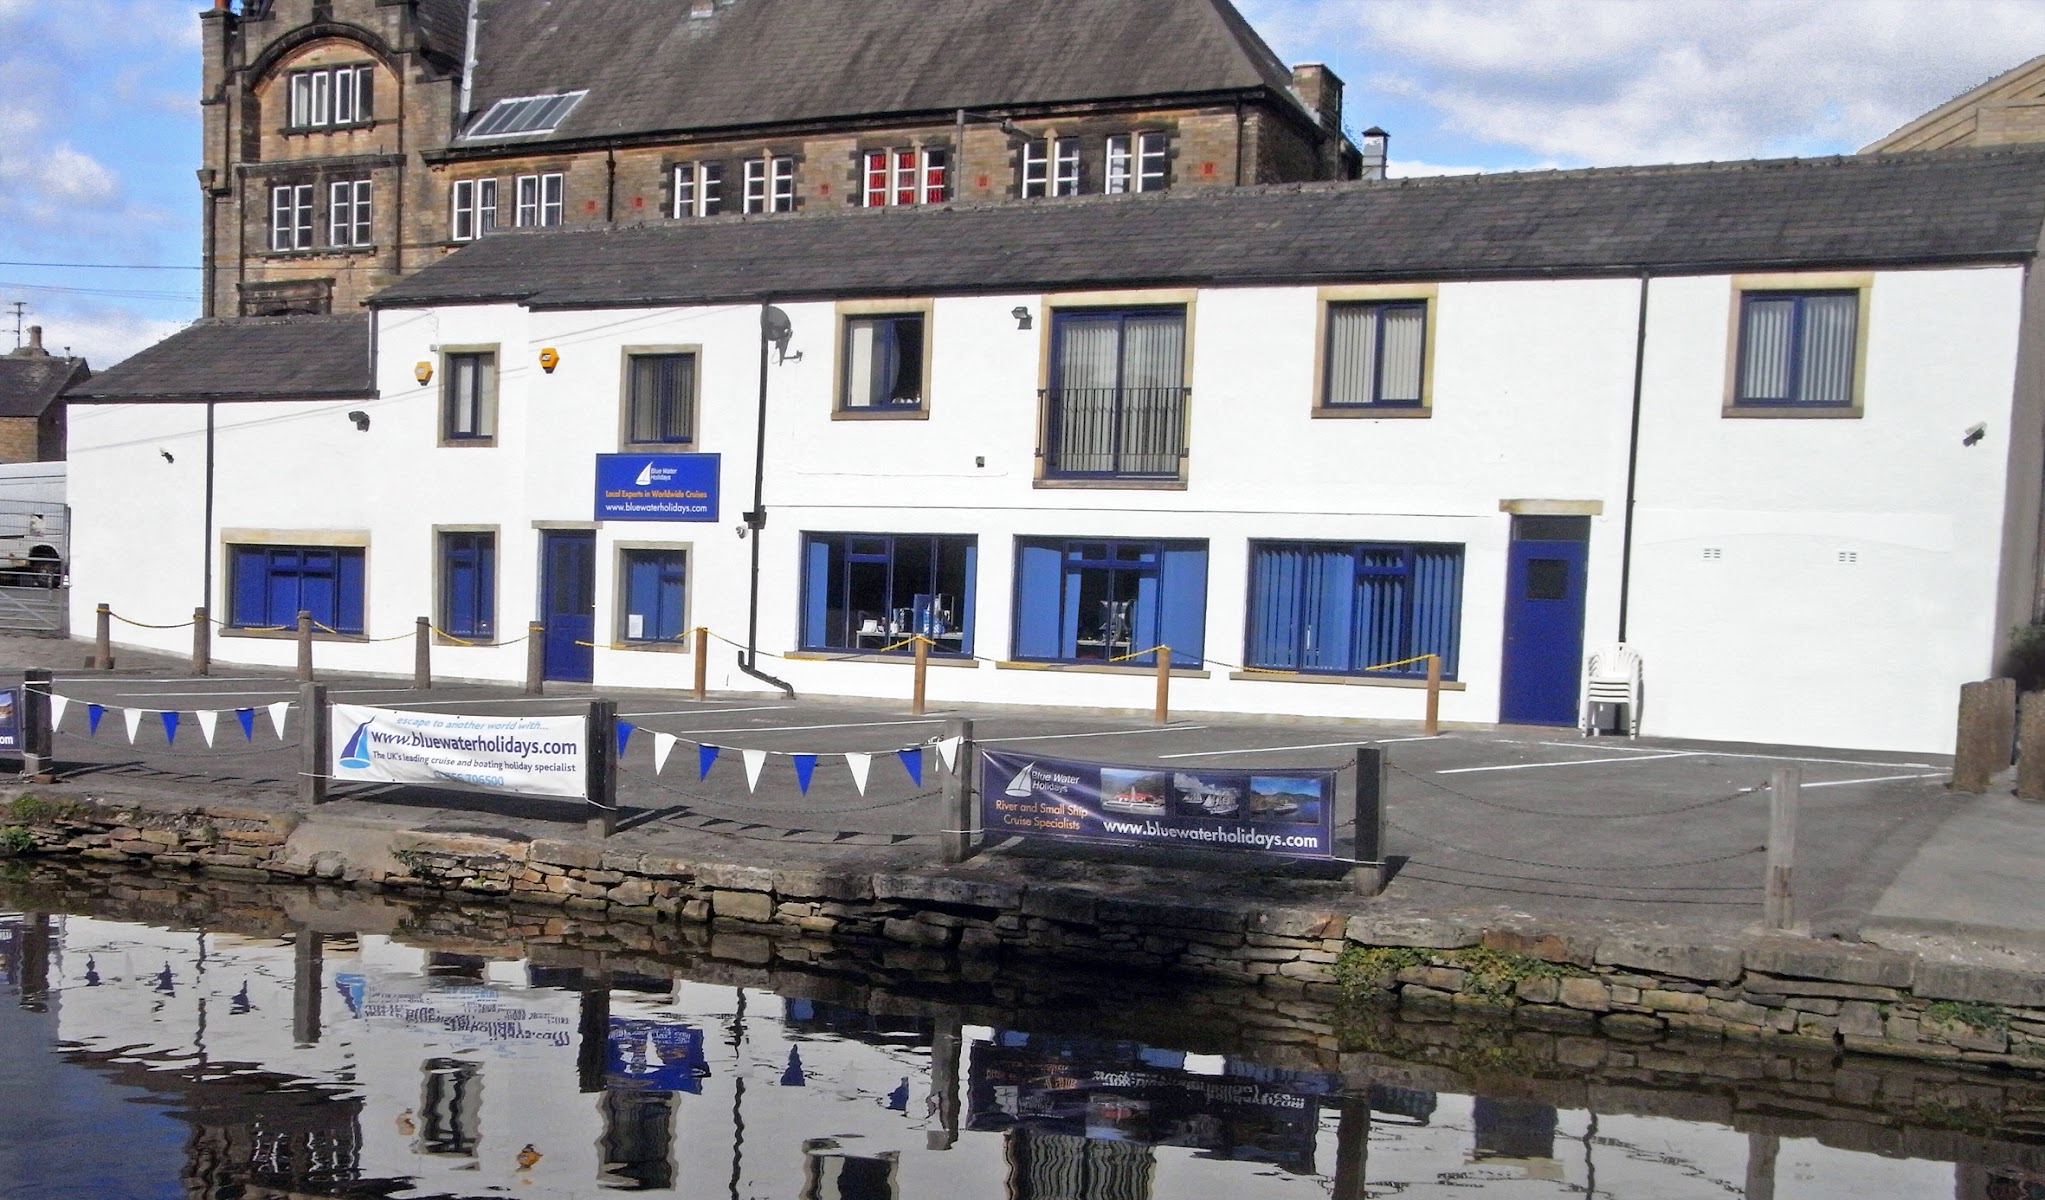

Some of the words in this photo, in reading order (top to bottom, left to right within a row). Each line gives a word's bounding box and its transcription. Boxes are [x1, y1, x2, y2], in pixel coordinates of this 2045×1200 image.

[605, 490, 620, 498] Local
[621, 490, 643, 499] Experts
[644, 490, 651, 498] in
[652, 490, 684, 498] Worldwide
[685, 490, 707, 498] Cruises
[605, 502, 707, 514] www.bluewaterholidays.com
[397, 717, 431, 728] escape
[433, 720, 444, 728] to
[445, 720, 485, 730] another
[487, 721, 517, 730] world
[371, 731, 577, 758] www.bluewaterholidays.com
[373, 751, 386, 759] The
[387, 752, 402, 761] UK's
[403, 752, 429, 766] leading
[431, 757, 455, 765] cruise
[457, 758, 473, 767] and
[473, 759, 503, 771] boating
[504, 761, 532, 773] holiday
[534, 763, 576, 773] specialist
[1032, 771, 1051, 781] Blue
[1053, 773, 1080, 784] Water
[1032, 781, 1068, 793] Holidays
[996, 799, 1018, 811] River
[1020, 802, 1038, 813] and
[1040, 803, 1065, 815] Small
[1067, 804, 1088, 819] Ship
[1003, 813, 1032, 826] Cruise
[1033, 815, 1080, 830] Specialists
[1103, 820, 1318, 849] www.bluewaterholidays.com
